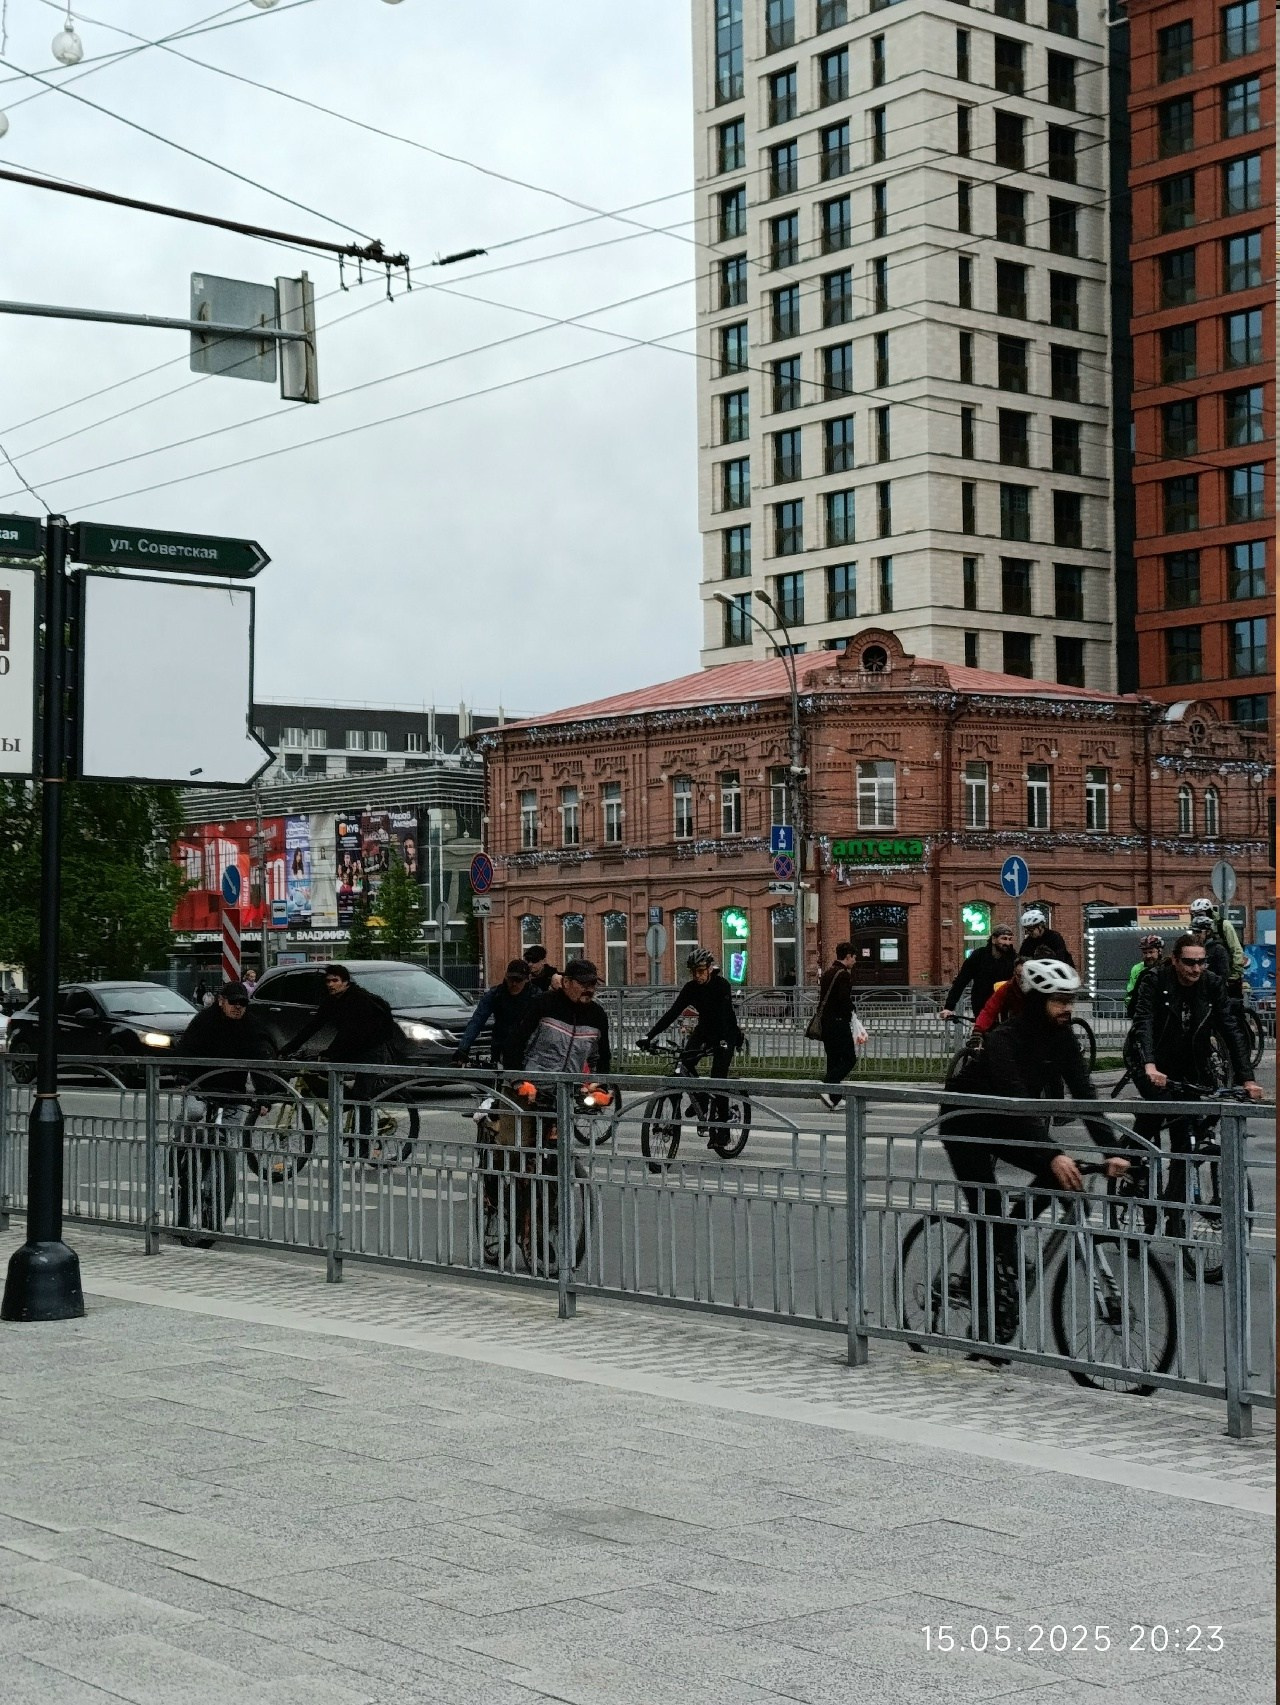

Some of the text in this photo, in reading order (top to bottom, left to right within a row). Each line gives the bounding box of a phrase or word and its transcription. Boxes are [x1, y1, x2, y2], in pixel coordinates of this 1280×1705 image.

[110, 538, 217, 559] ул. Советская
[833, 839, 923, 856] аптека
[296, 930, 351, 941] ВЛАДИМИРА
